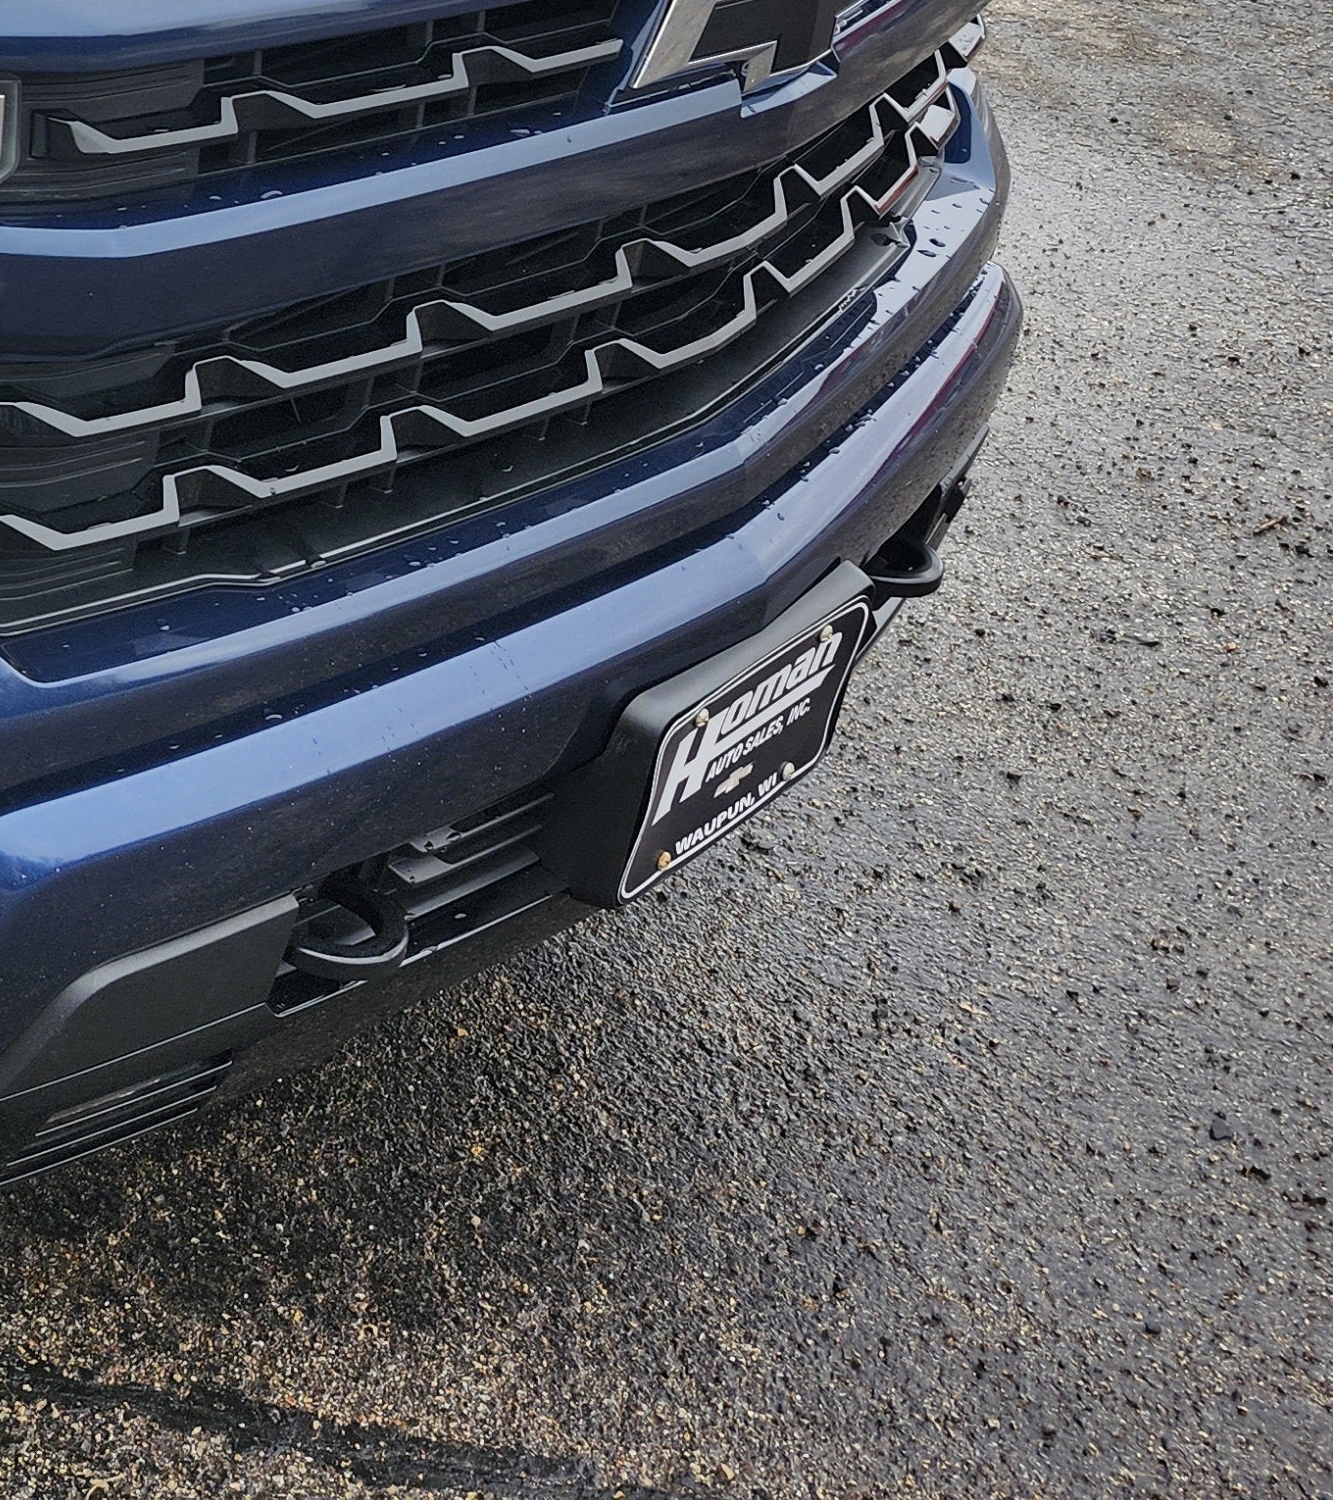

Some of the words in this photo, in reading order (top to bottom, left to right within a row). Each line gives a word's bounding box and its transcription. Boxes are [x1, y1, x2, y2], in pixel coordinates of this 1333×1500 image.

[651, 631, 843, 827] Homan
[704, 742, 744, 783] AUTO
[742, 714, 784, 756] SALES,
[786, 697, 811, 726] INC.
[674, 790, 756, 855] WAUPUN,
[757, 771, 778, 797] WI
